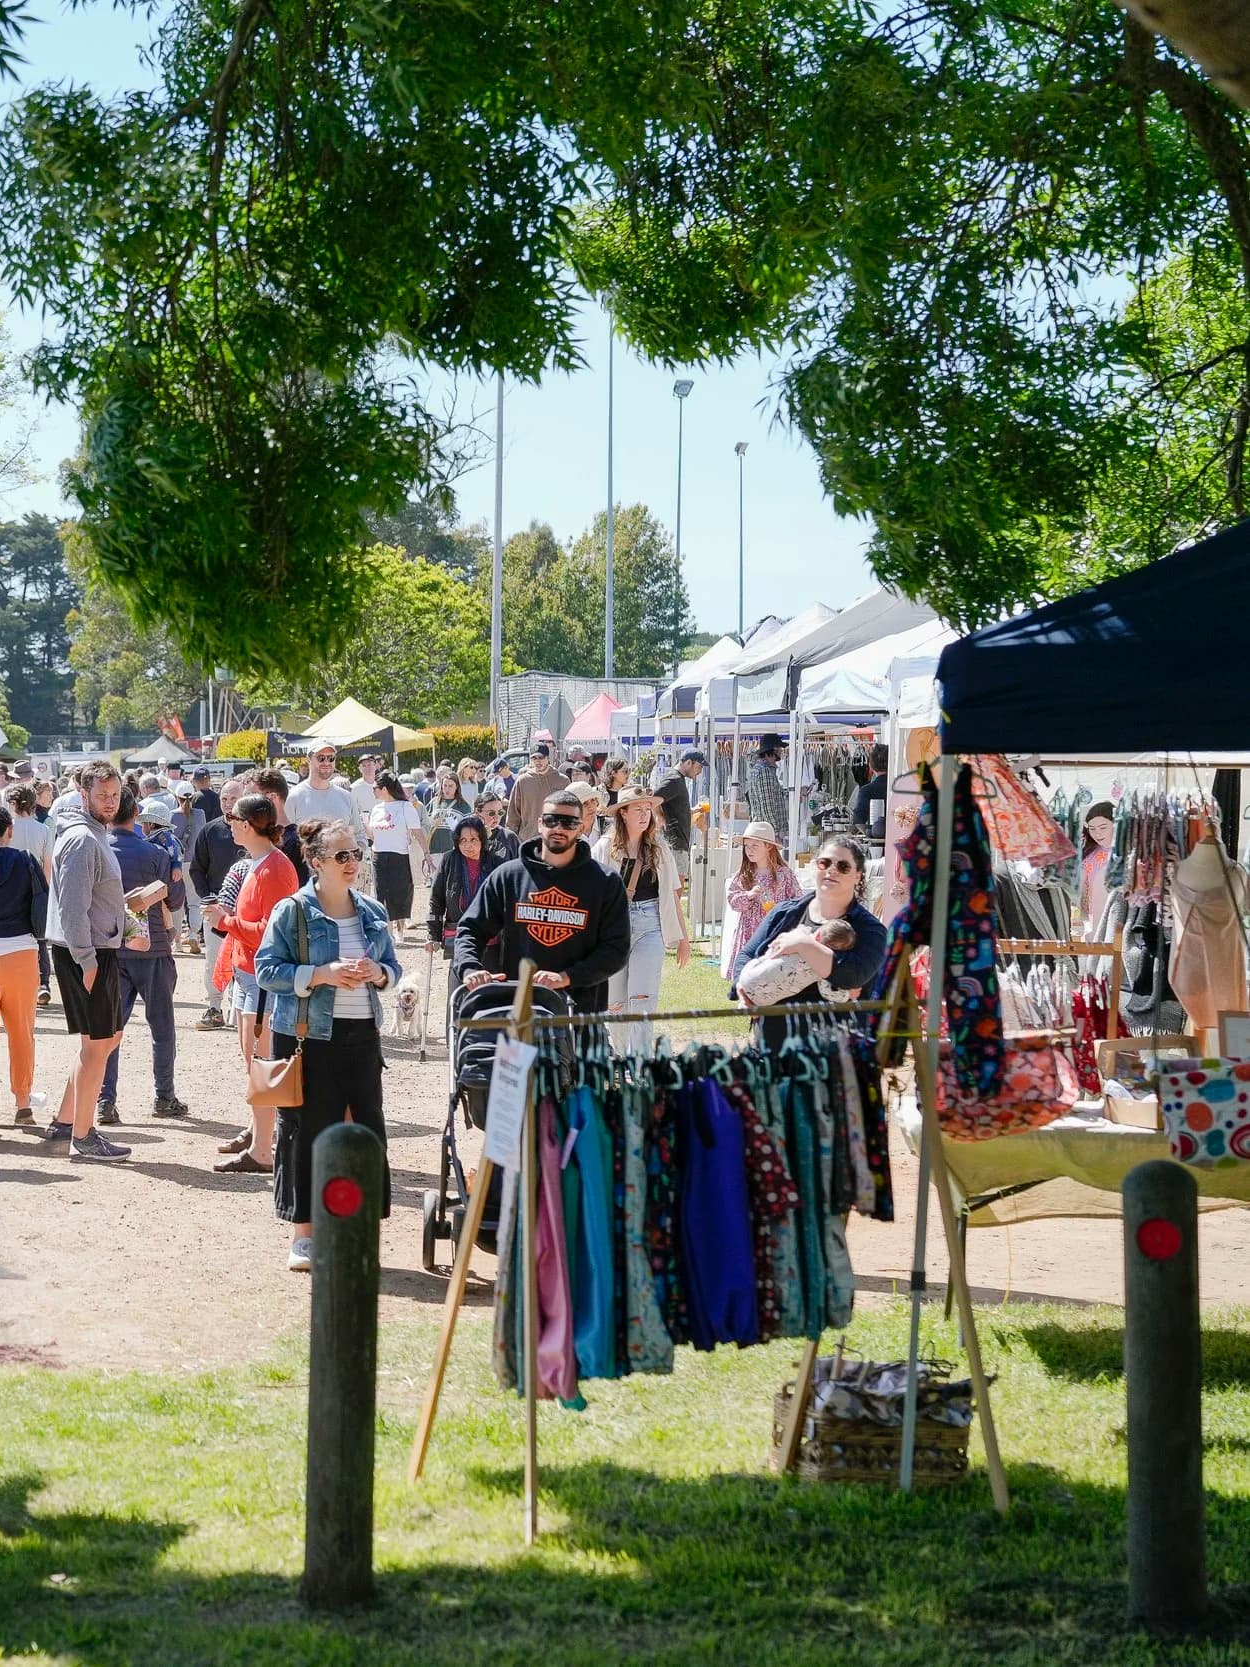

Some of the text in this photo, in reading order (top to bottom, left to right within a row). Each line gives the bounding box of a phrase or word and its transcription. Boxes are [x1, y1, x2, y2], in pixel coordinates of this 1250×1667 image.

[534, 890, 571, 907] MOTOR
[517, 906, 586, 926] HARLEY-DAVIDSON
[530, 924, 568, 943] CYCLES
